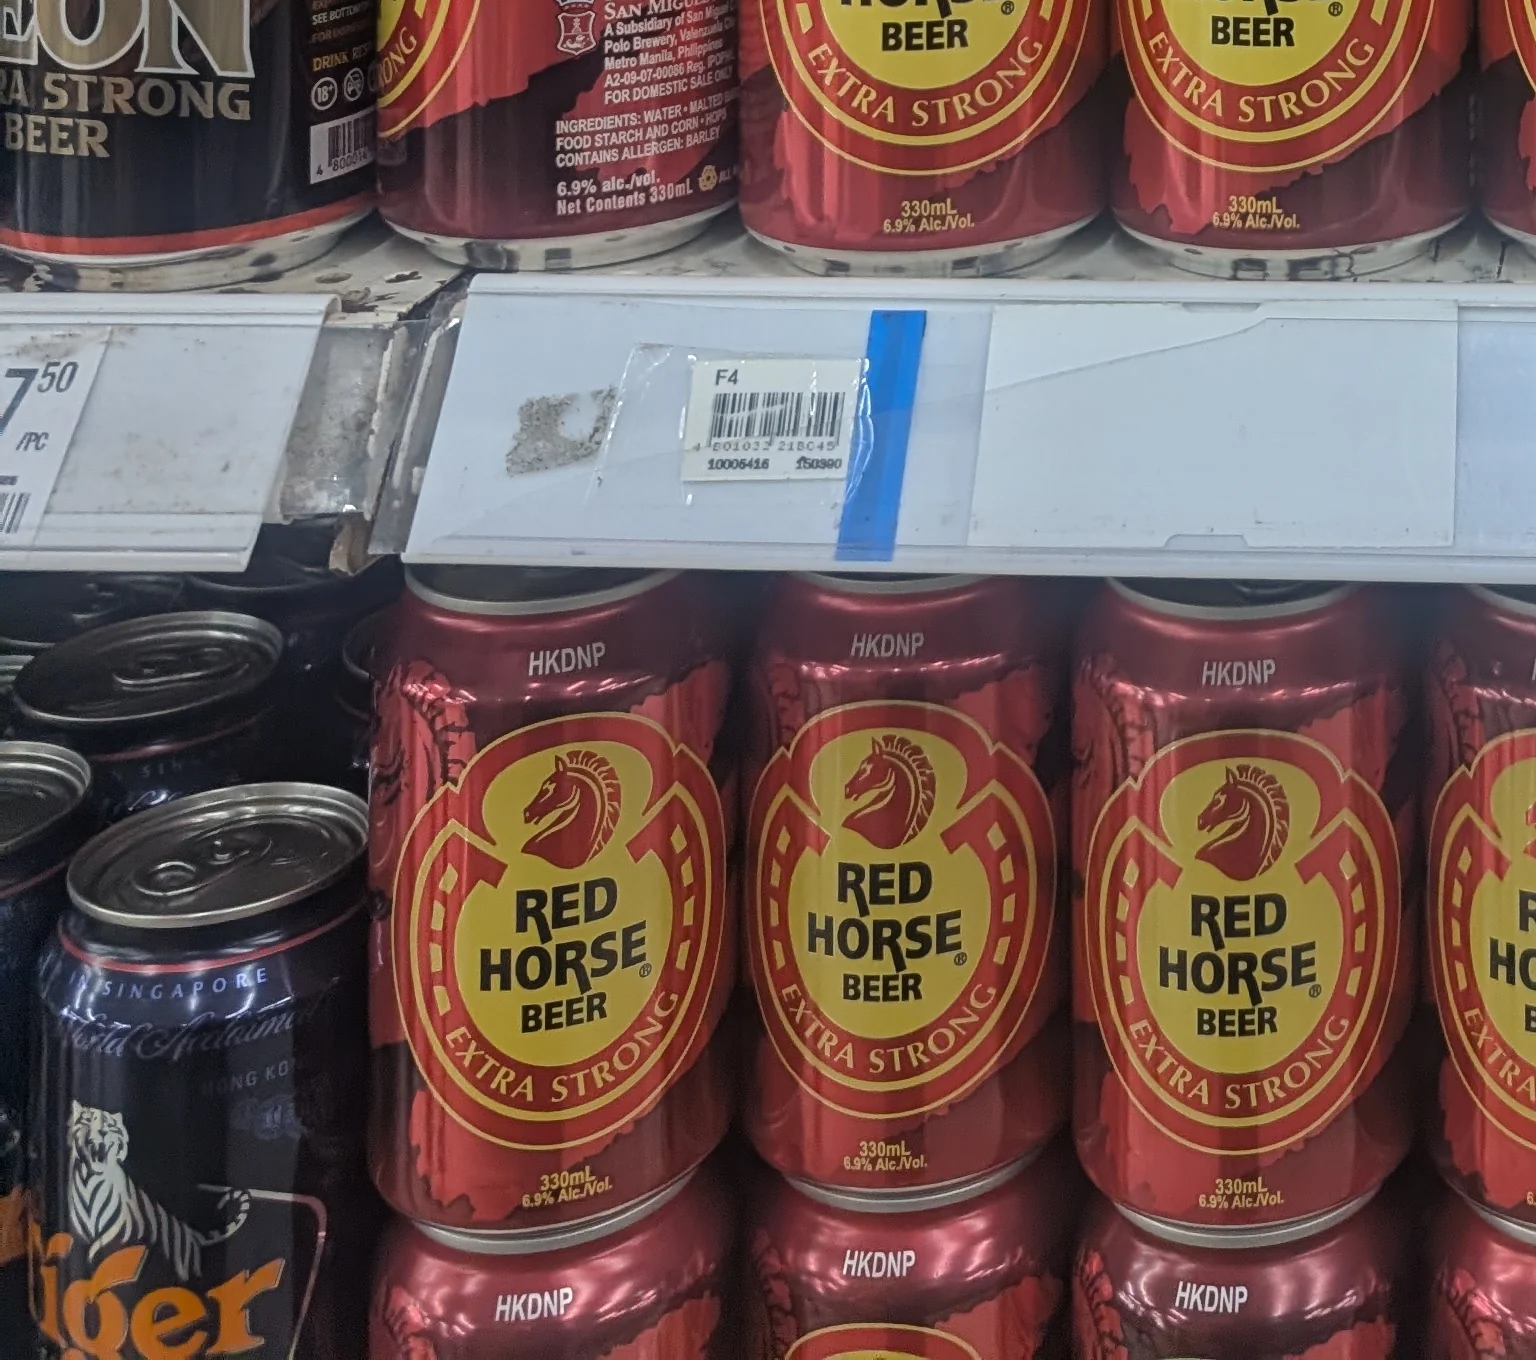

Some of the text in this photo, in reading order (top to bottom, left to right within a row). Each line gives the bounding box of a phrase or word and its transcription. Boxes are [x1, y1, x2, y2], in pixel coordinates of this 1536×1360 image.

[881, 18, 969, 52] BEER
[43, 72, 251, 121] STRONG
[4, 112, 110, 157] BEER
[556, 106, 682, 134] INGREDIENTS: WATER
[556, 130, 643, 151] FOOD STARCH
[556, 136, 684, 168] CONTAINS ALLERGEN:
[556, 182, 693, 216] Net Contents 330mL
[715, 369, 739, 385] F4
[528, 642, 606, 677] HKDNP
[514, 877, 618, 944] RED
[479, 921, 647, 995] HORSE
[101, 966, 269, 1000] SINGAPORE
[521, 991, 608, 1034] BEER
[444, 988, 679, 1104] EXTRA STRONG
[496, 1287, 574, 1322] HKDNP
